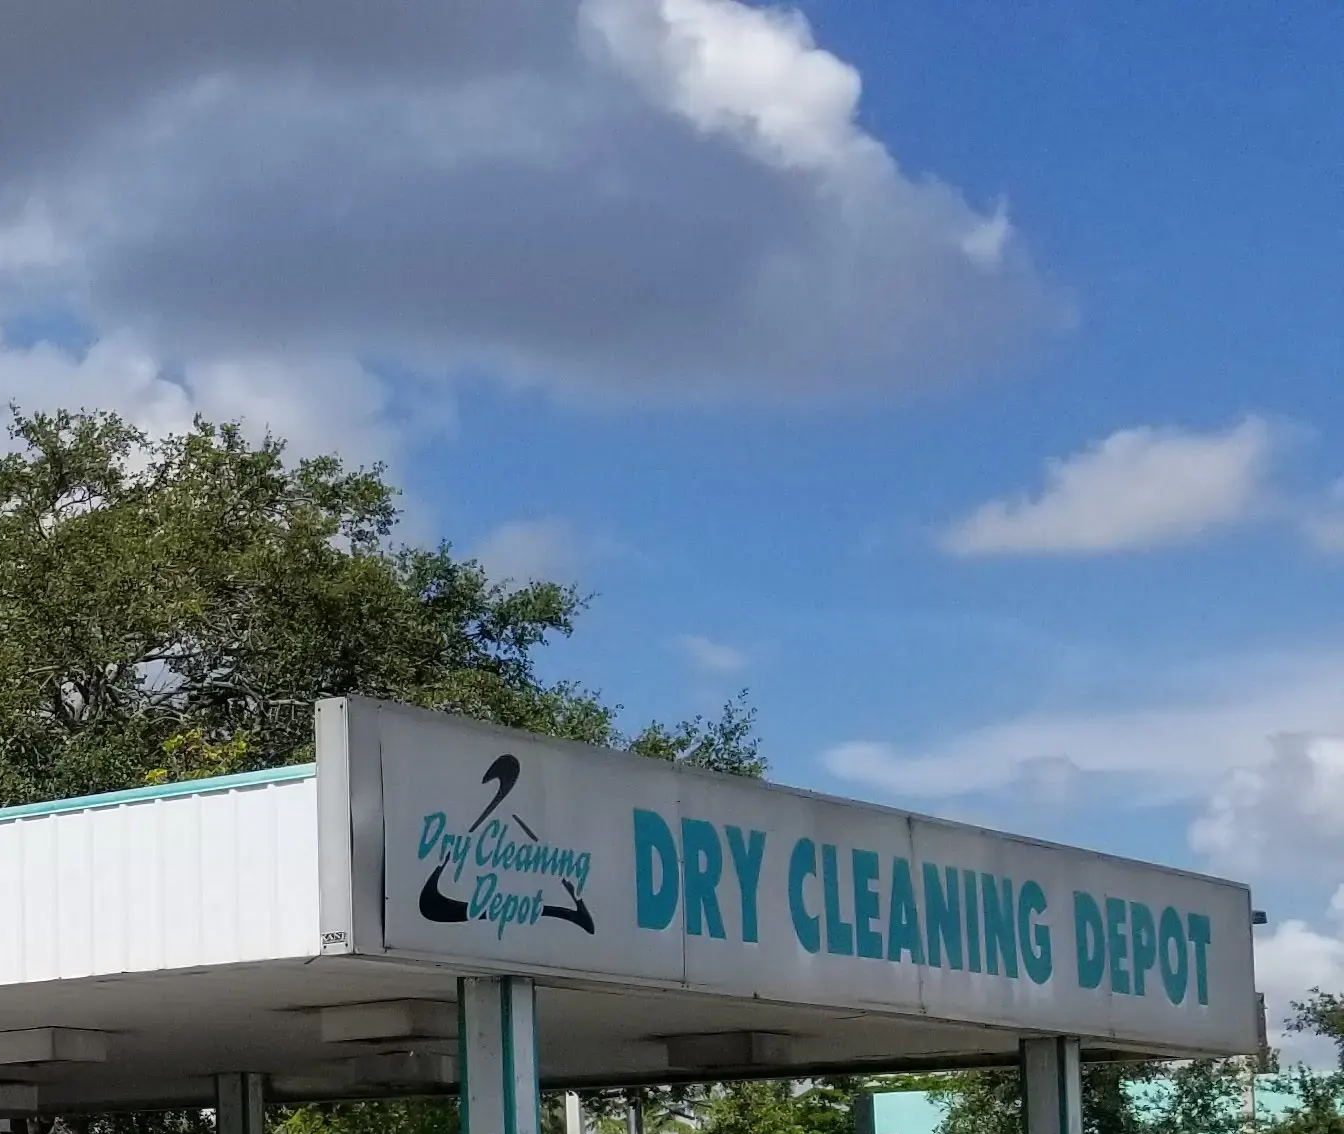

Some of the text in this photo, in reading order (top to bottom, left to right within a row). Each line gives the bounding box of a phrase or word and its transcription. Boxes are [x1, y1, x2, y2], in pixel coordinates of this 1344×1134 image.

[417, 811, 592, 897] Dry Cleaning
[468, 873, 544, 941] Depot
[633, 807, 1210, 1007] DRY CLEANING DEPOT
